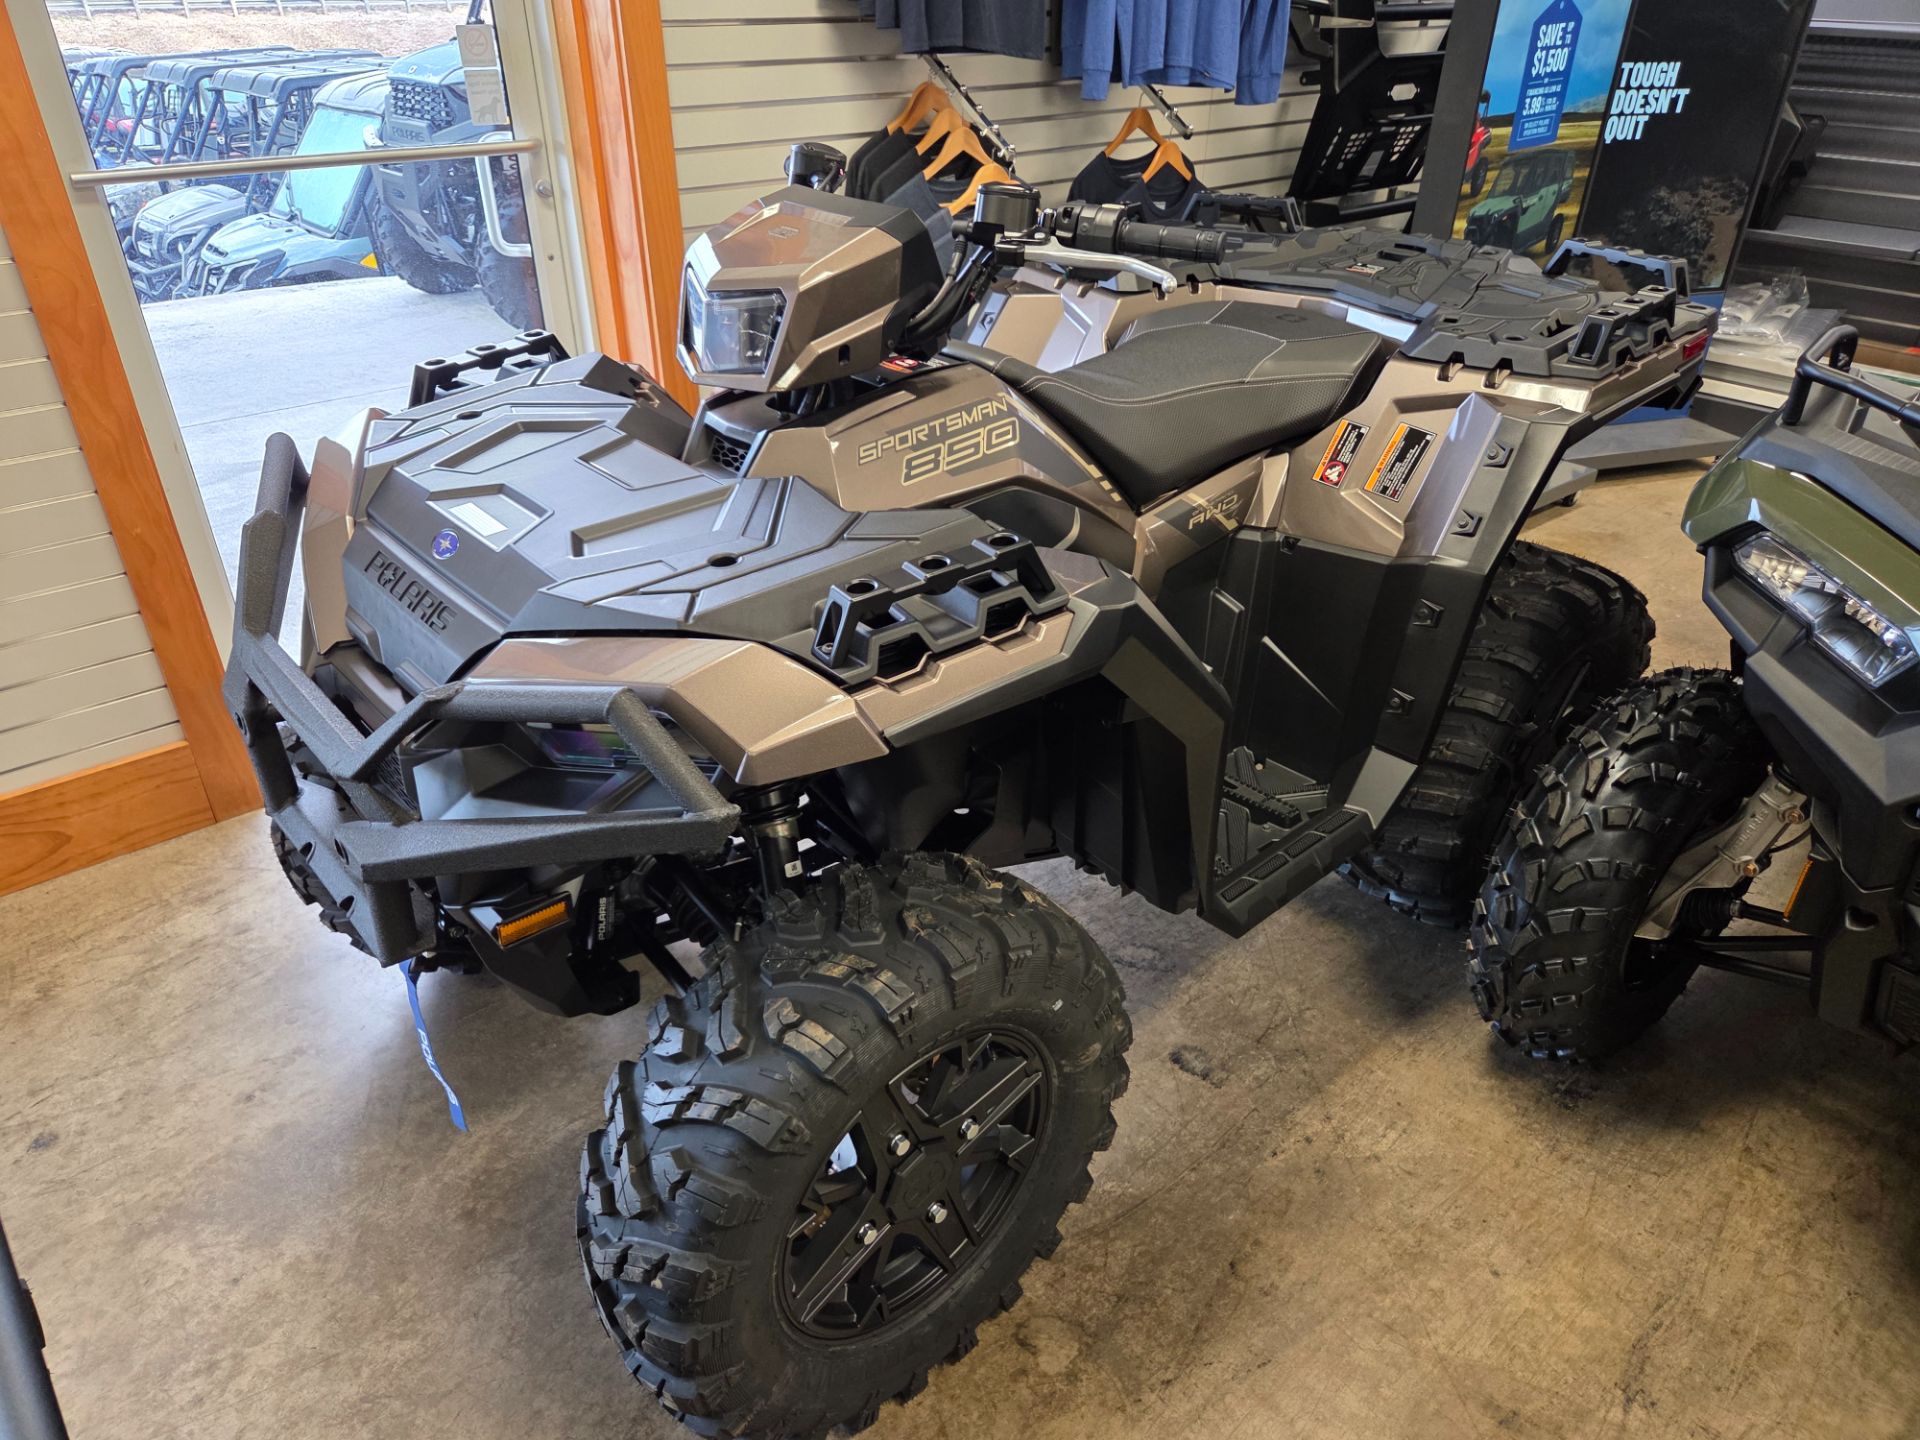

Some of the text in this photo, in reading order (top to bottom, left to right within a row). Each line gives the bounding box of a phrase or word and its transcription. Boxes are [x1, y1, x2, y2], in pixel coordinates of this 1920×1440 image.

[1537, 23, 1566, 48] SAVE
[1620, 61, 1681, 88] TOUGH
[1610, 88, 1691, 115] DOESN'T
[1604, 115, 1649, 144] QUIT
[859, 397, 1008, 466] SPORTSMAN
[901, 417, 1019, 486] 850
[1188, 494, 1238, 530] AWD
[364, 550, 458, 635] POLARIS
[598, 897, 607, 940] POLARIS
